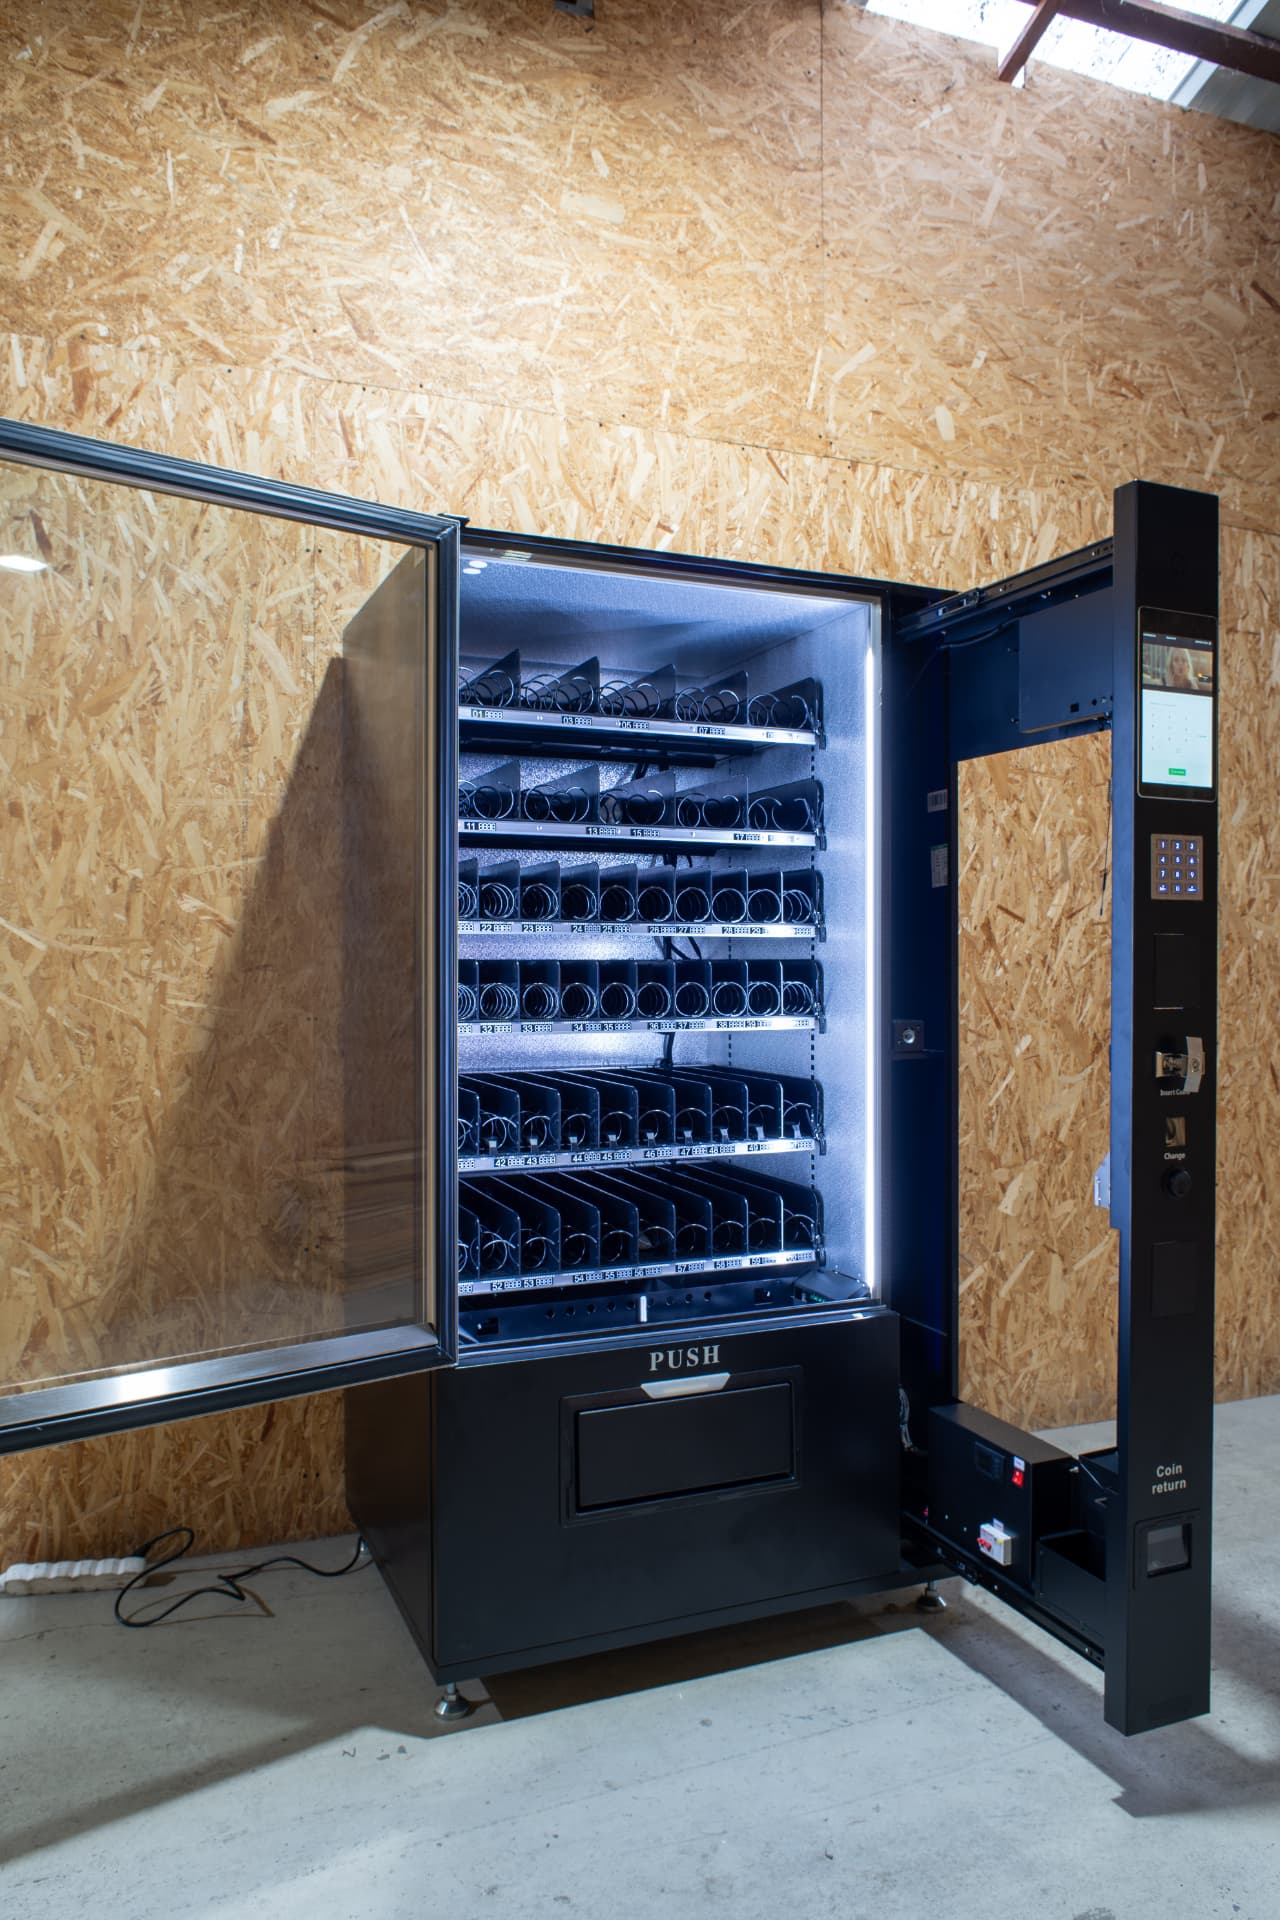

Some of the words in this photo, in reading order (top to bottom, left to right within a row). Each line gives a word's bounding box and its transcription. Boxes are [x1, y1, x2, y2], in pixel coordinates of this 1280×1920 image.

[1164, 1152, 1186, 1160] Change
[649, 1344, 721, 1372] PUSH
[1156, 1463, 1183, 1478] Coin
[1151, 1479, 1187, 1495] return
